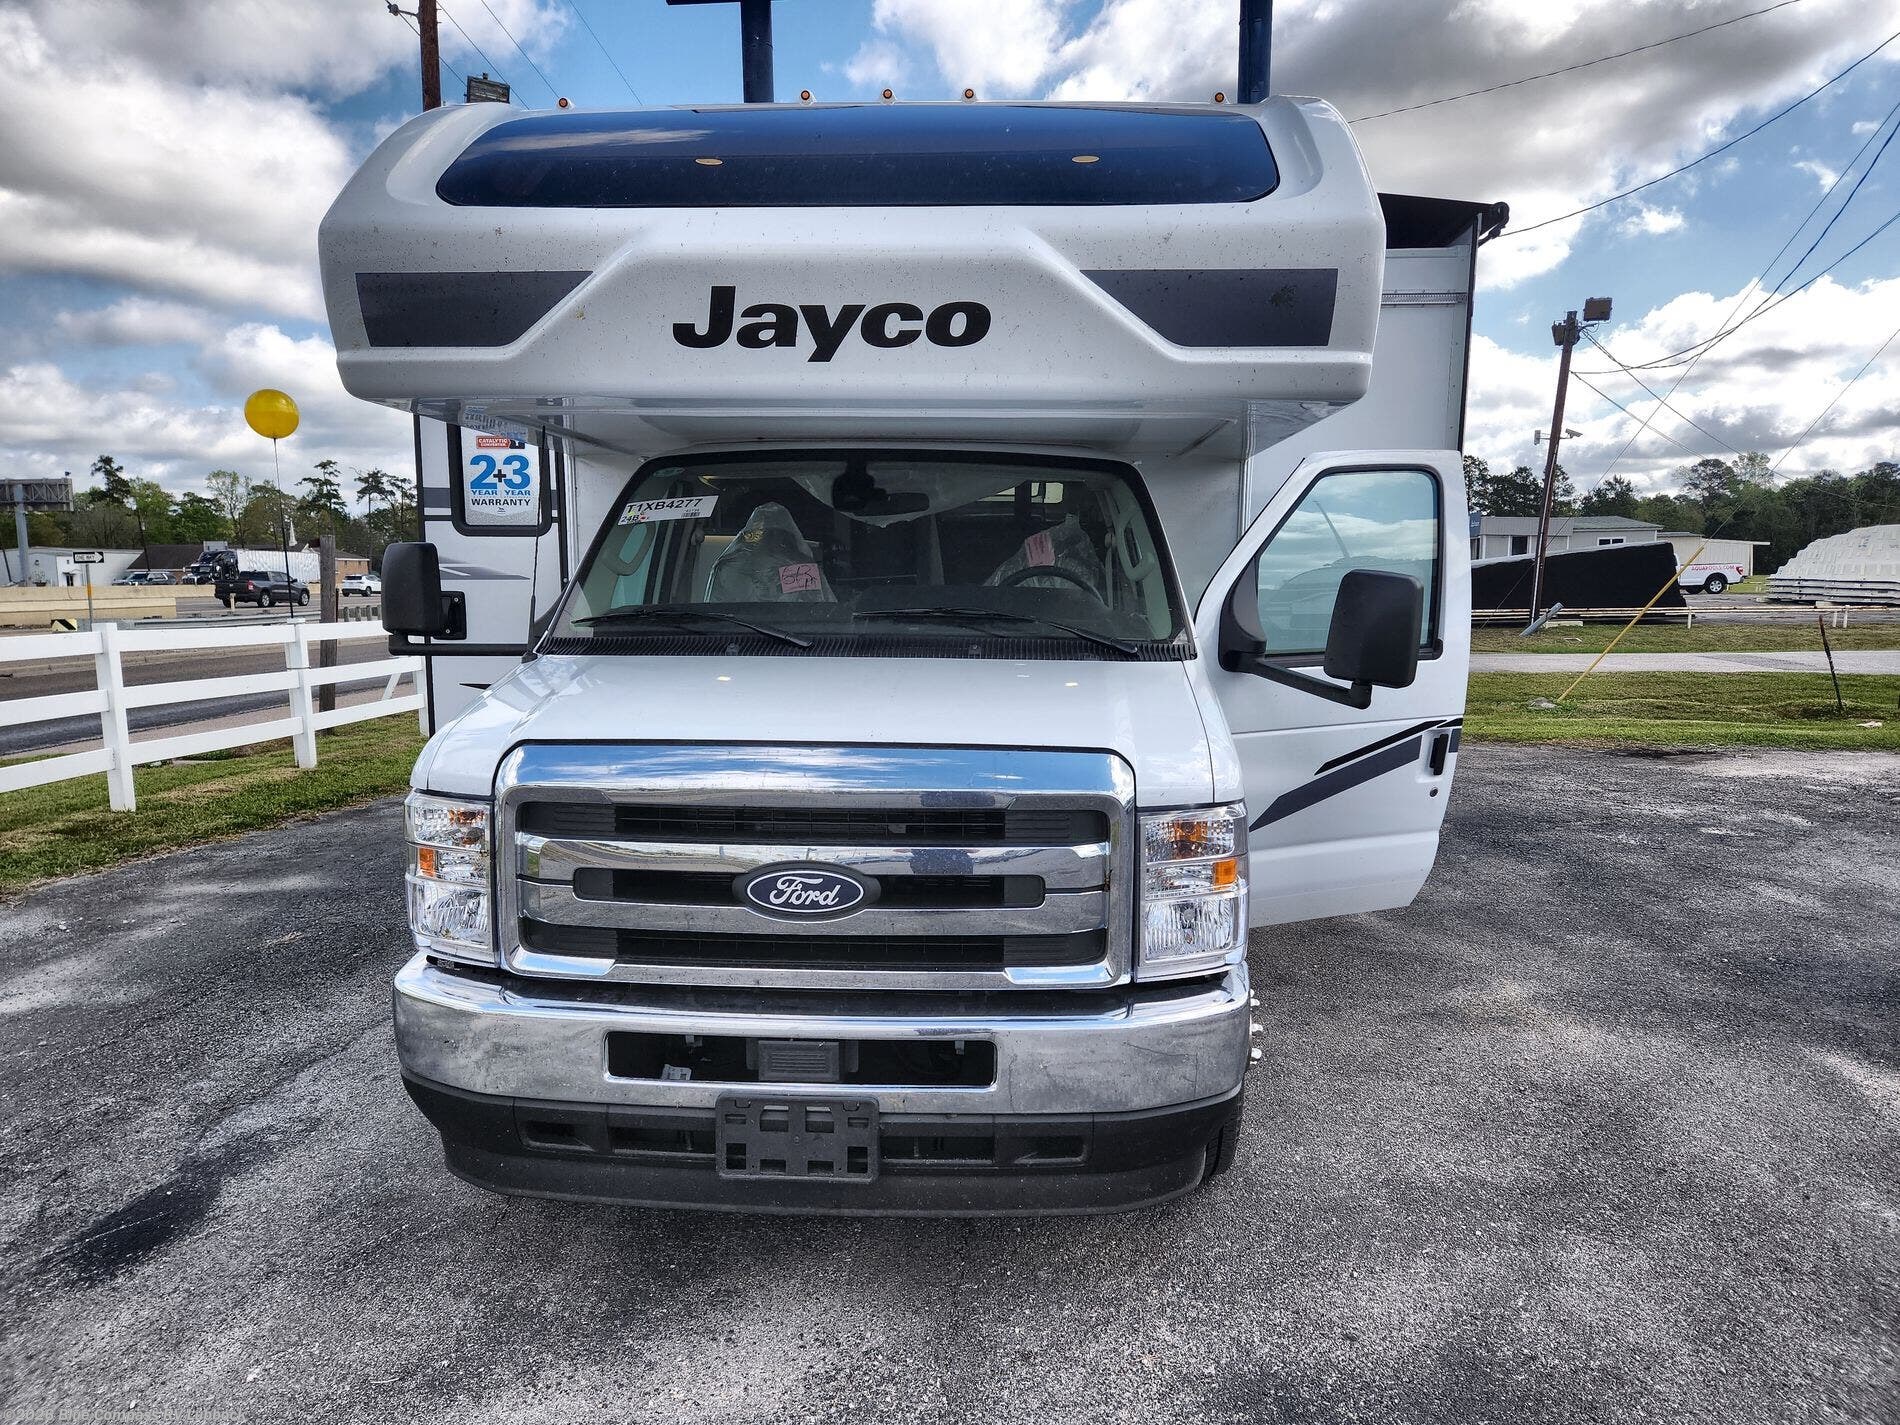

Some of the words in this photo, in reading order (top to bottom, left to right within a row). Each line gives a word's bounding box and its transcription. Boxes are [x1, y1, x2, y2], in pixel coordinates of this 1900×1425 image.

[672, 285, 991, 363] Jayco
[471, 498, 531, 506] WARRANTY
[627, 498, 704, 514] T1XB4277
[769, 875, 841, 906] Ford
